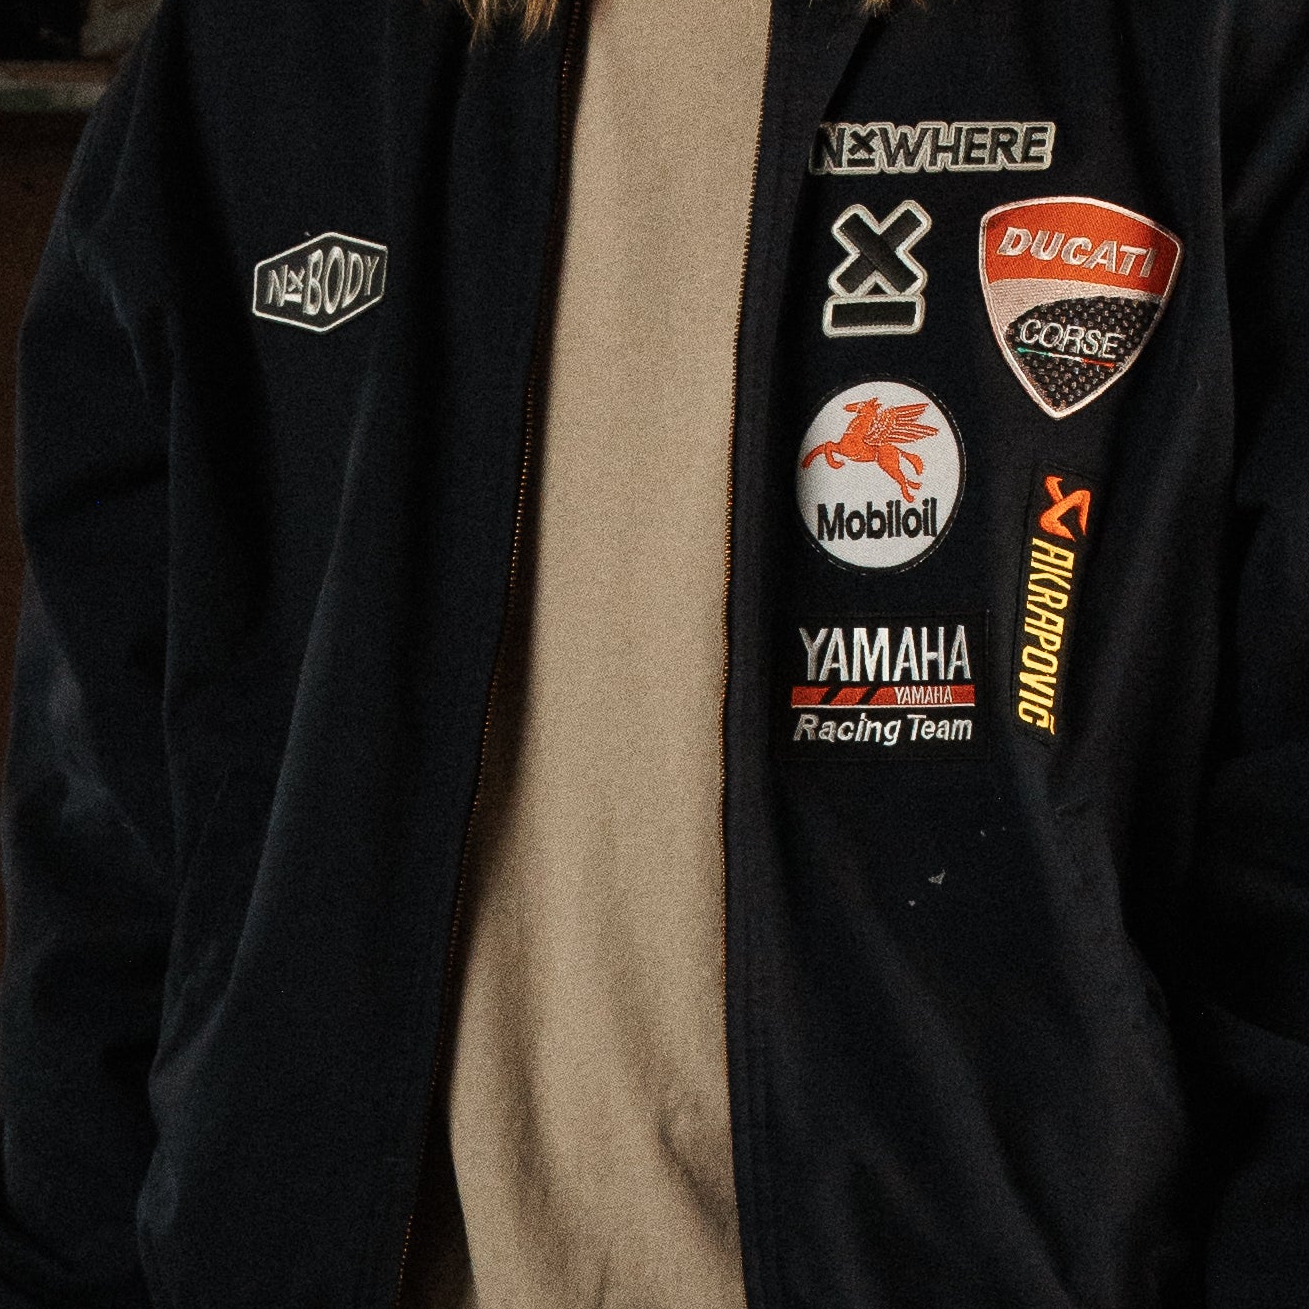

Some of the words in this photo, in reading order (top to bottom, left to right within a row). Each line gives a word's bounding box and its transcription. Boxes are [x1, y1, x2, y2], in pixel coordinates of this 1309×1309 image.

[998, 226, 1157, 279] DUCATI
[1019, 318, 1127, 360] CORSE
[817, 497, 938, 541] Mobiloil
[799, 625, 971, 682] YAMAHA
[893, 685, 954, 705] YAMAHA
[793, 713, 903, 746] Racing
[906, 714, 973, 741] Team
